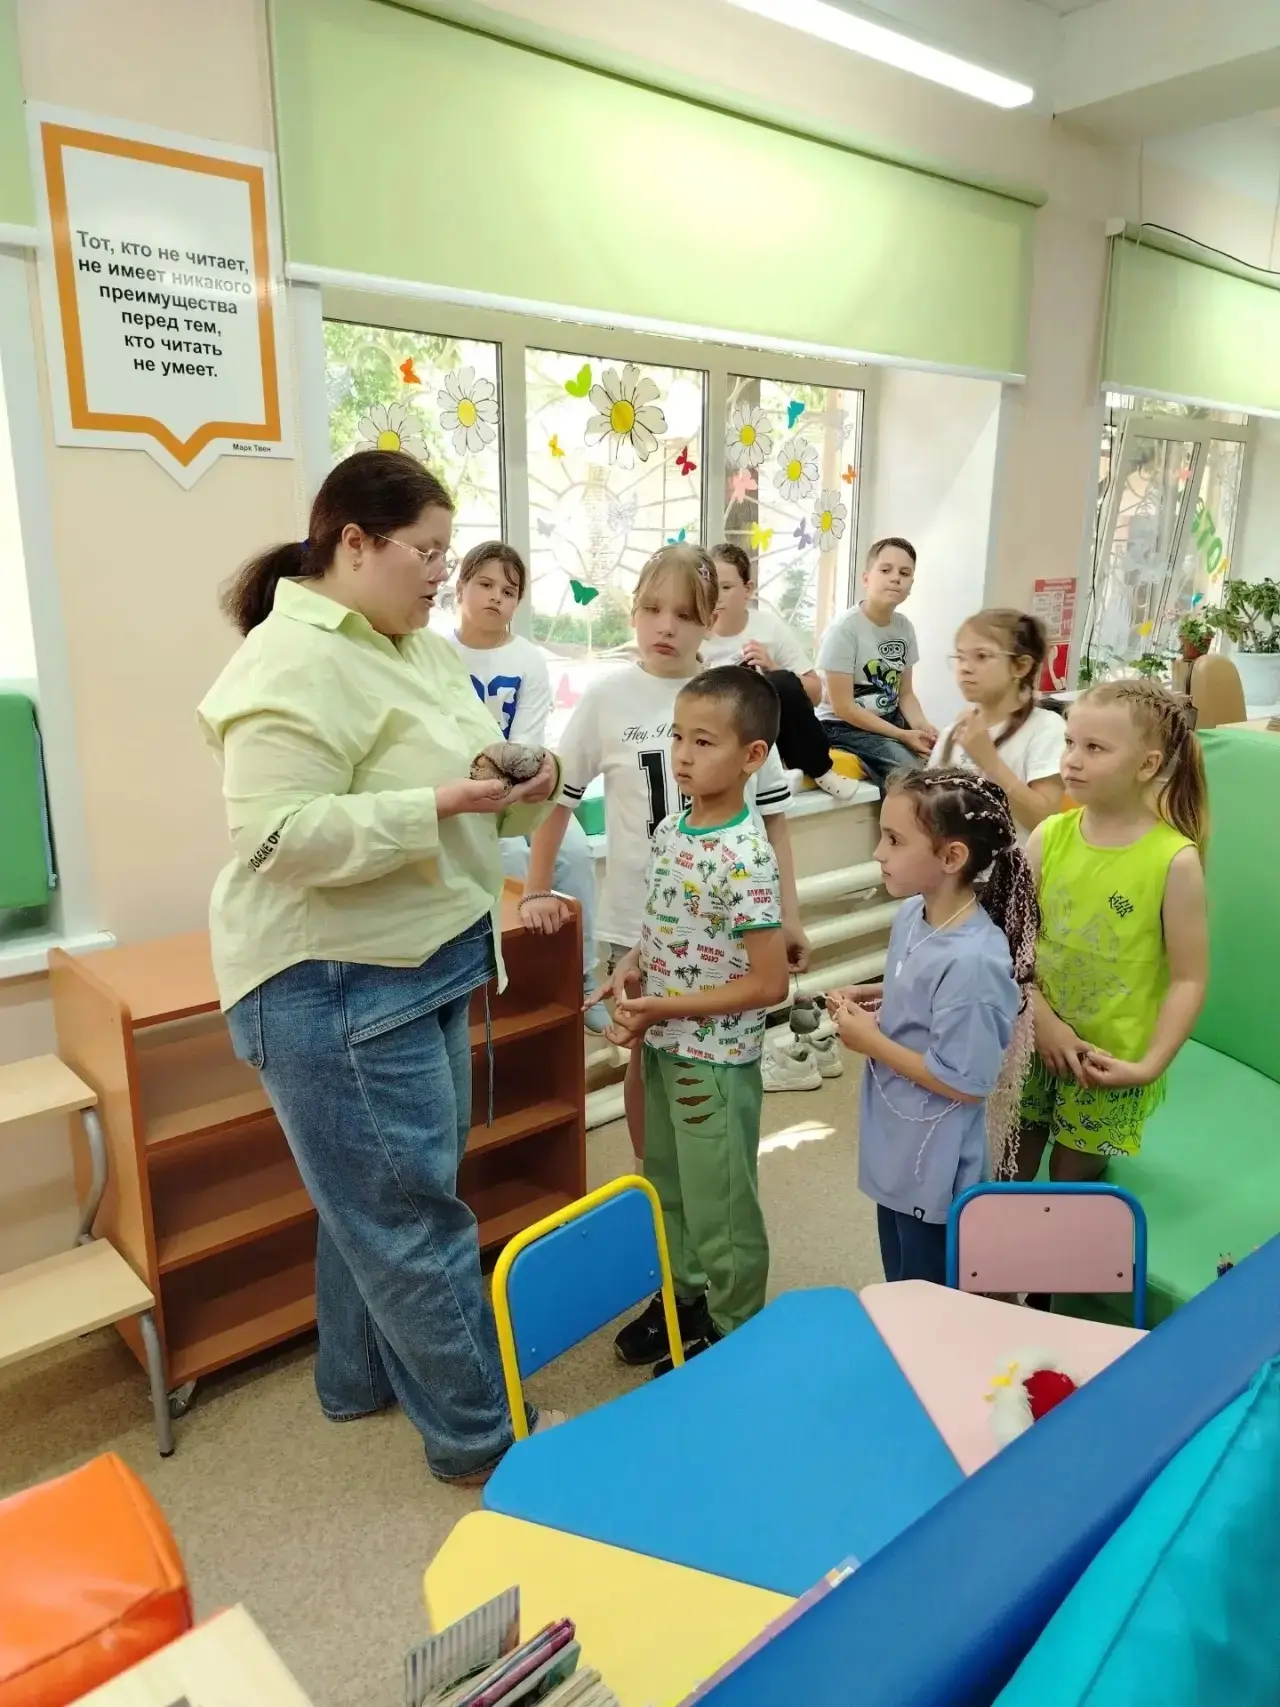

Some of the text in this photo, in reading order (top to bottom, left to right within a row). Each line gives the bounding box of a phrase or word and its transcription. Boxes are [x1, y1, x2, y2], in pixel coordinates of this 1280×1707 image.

[76, 229, 249, 275] Тот, кто не читает,
[78, 256, 252, 296] не имеет никакого
[99, 284, 238, 315] преимущества
[121, 310, 222, 336] перед тем,
[124, 334, 223, 356] кто читать
[133, 357, 218, 378] не умеет.
[232, 443, 272, 453] Марк Твен
[651, 722, 667, 738] I
